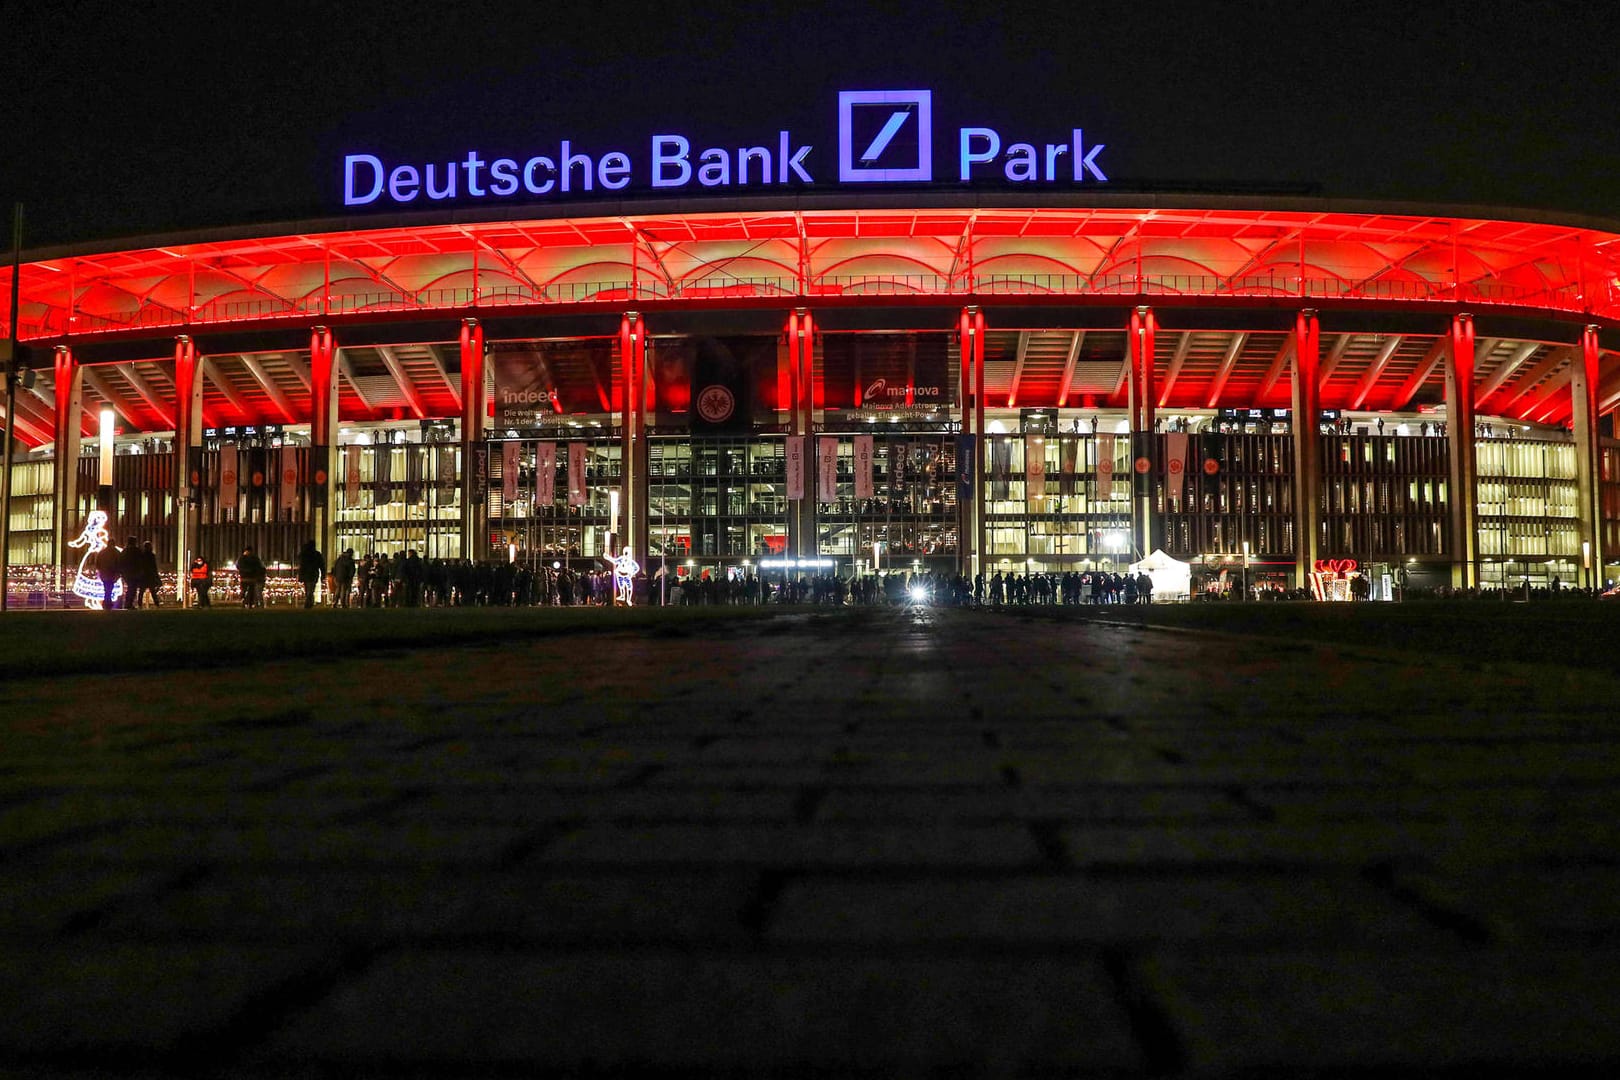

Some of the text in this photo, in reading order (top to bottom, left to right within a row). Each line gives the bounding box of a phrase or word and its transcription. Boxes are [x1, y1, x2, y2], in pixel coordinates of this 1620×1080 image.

[344, 127, 1109, 206] Deutsche Bank Park
[503, 387, 558, 403] indeed
[886, 384, 939, 397] mainova
[504, 409, 517, 417] Die
[520, 417, 534, 425] der
[475, 449, 487, 494] indeed
[892, 444, 906, 491] indeed
